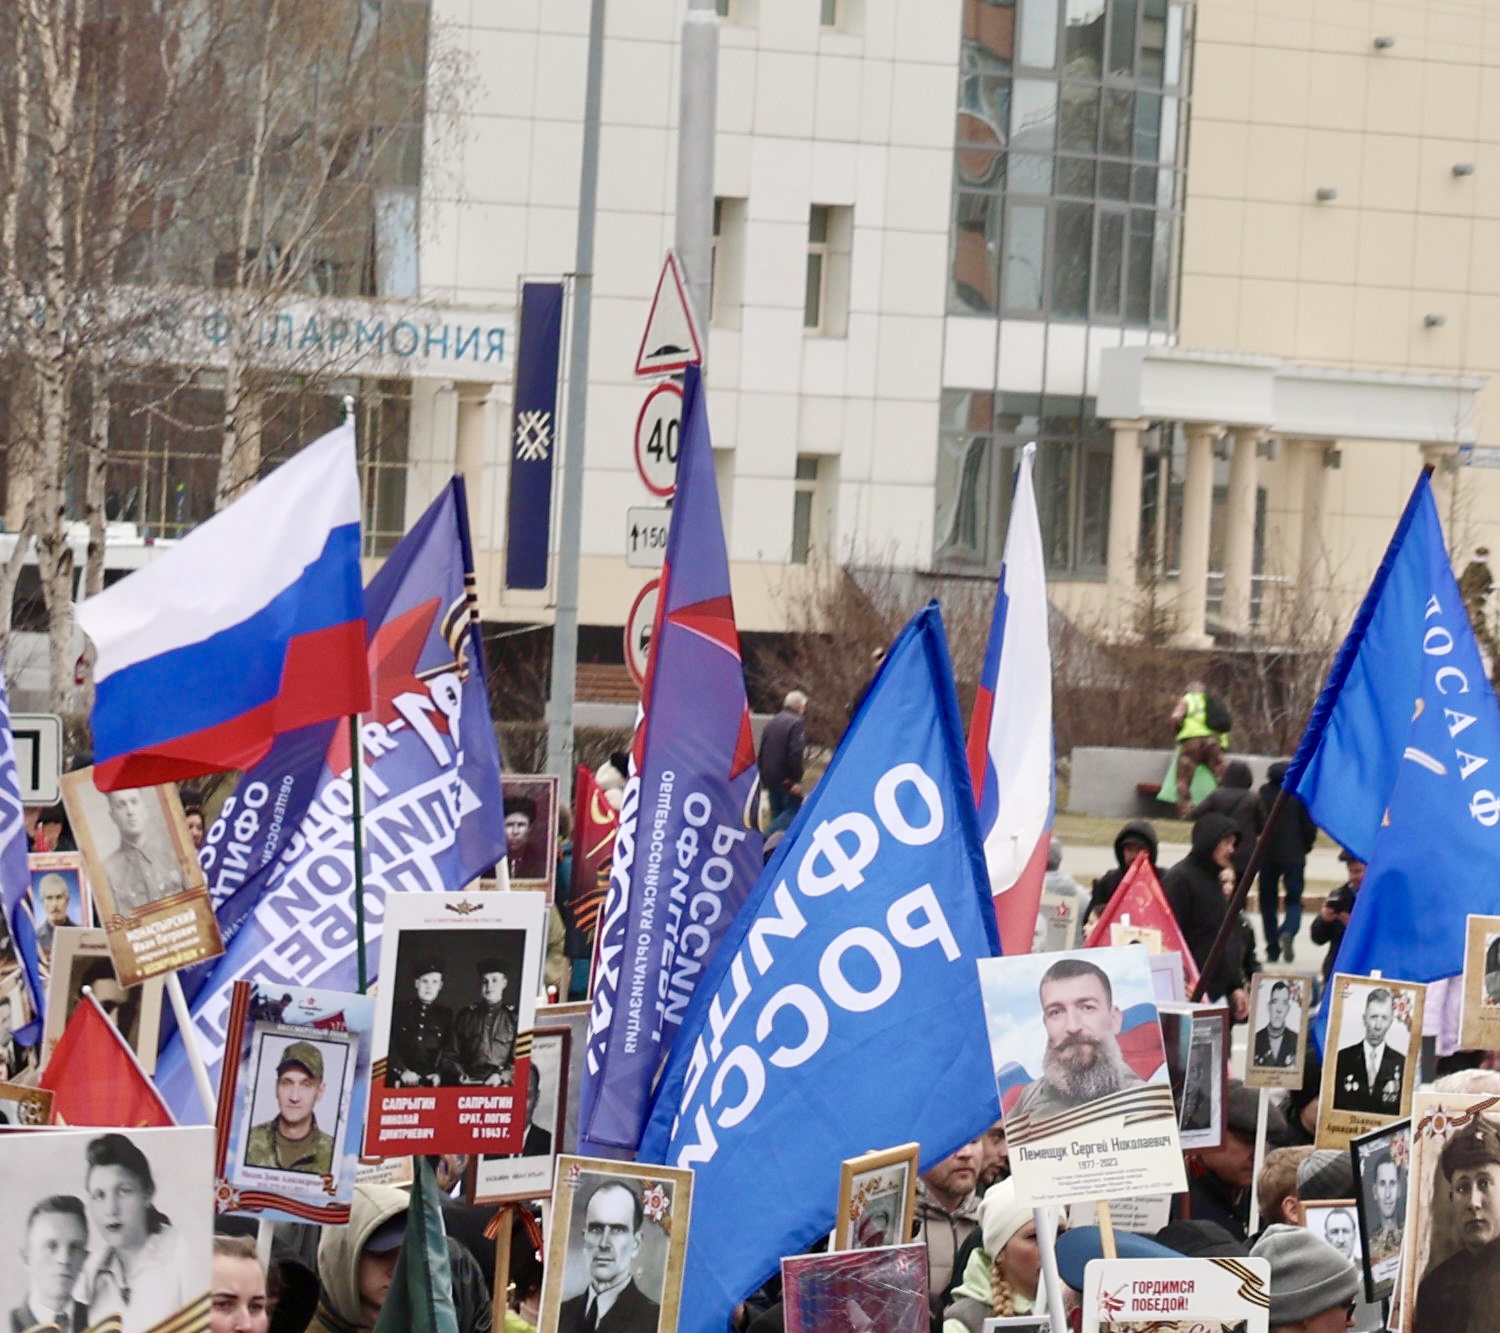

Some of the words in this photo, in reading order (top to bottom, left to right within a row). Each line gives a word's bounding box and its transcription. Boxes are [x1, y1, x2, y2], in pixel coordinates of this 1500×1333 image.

[381, 1097, 436, 1111] САПРЫГИН
[457, 1096, 513, 1110] САПРЫГИН
[1071, 1138, 1110, 1157] Сергей
[1111, 1134, 1172, 1152] Николаевич
[1132, 1280, 1195, 1295] ГОРДИМСЯ
[1132, 1296, 1189, 1312] ПОБЕДОЙ!
